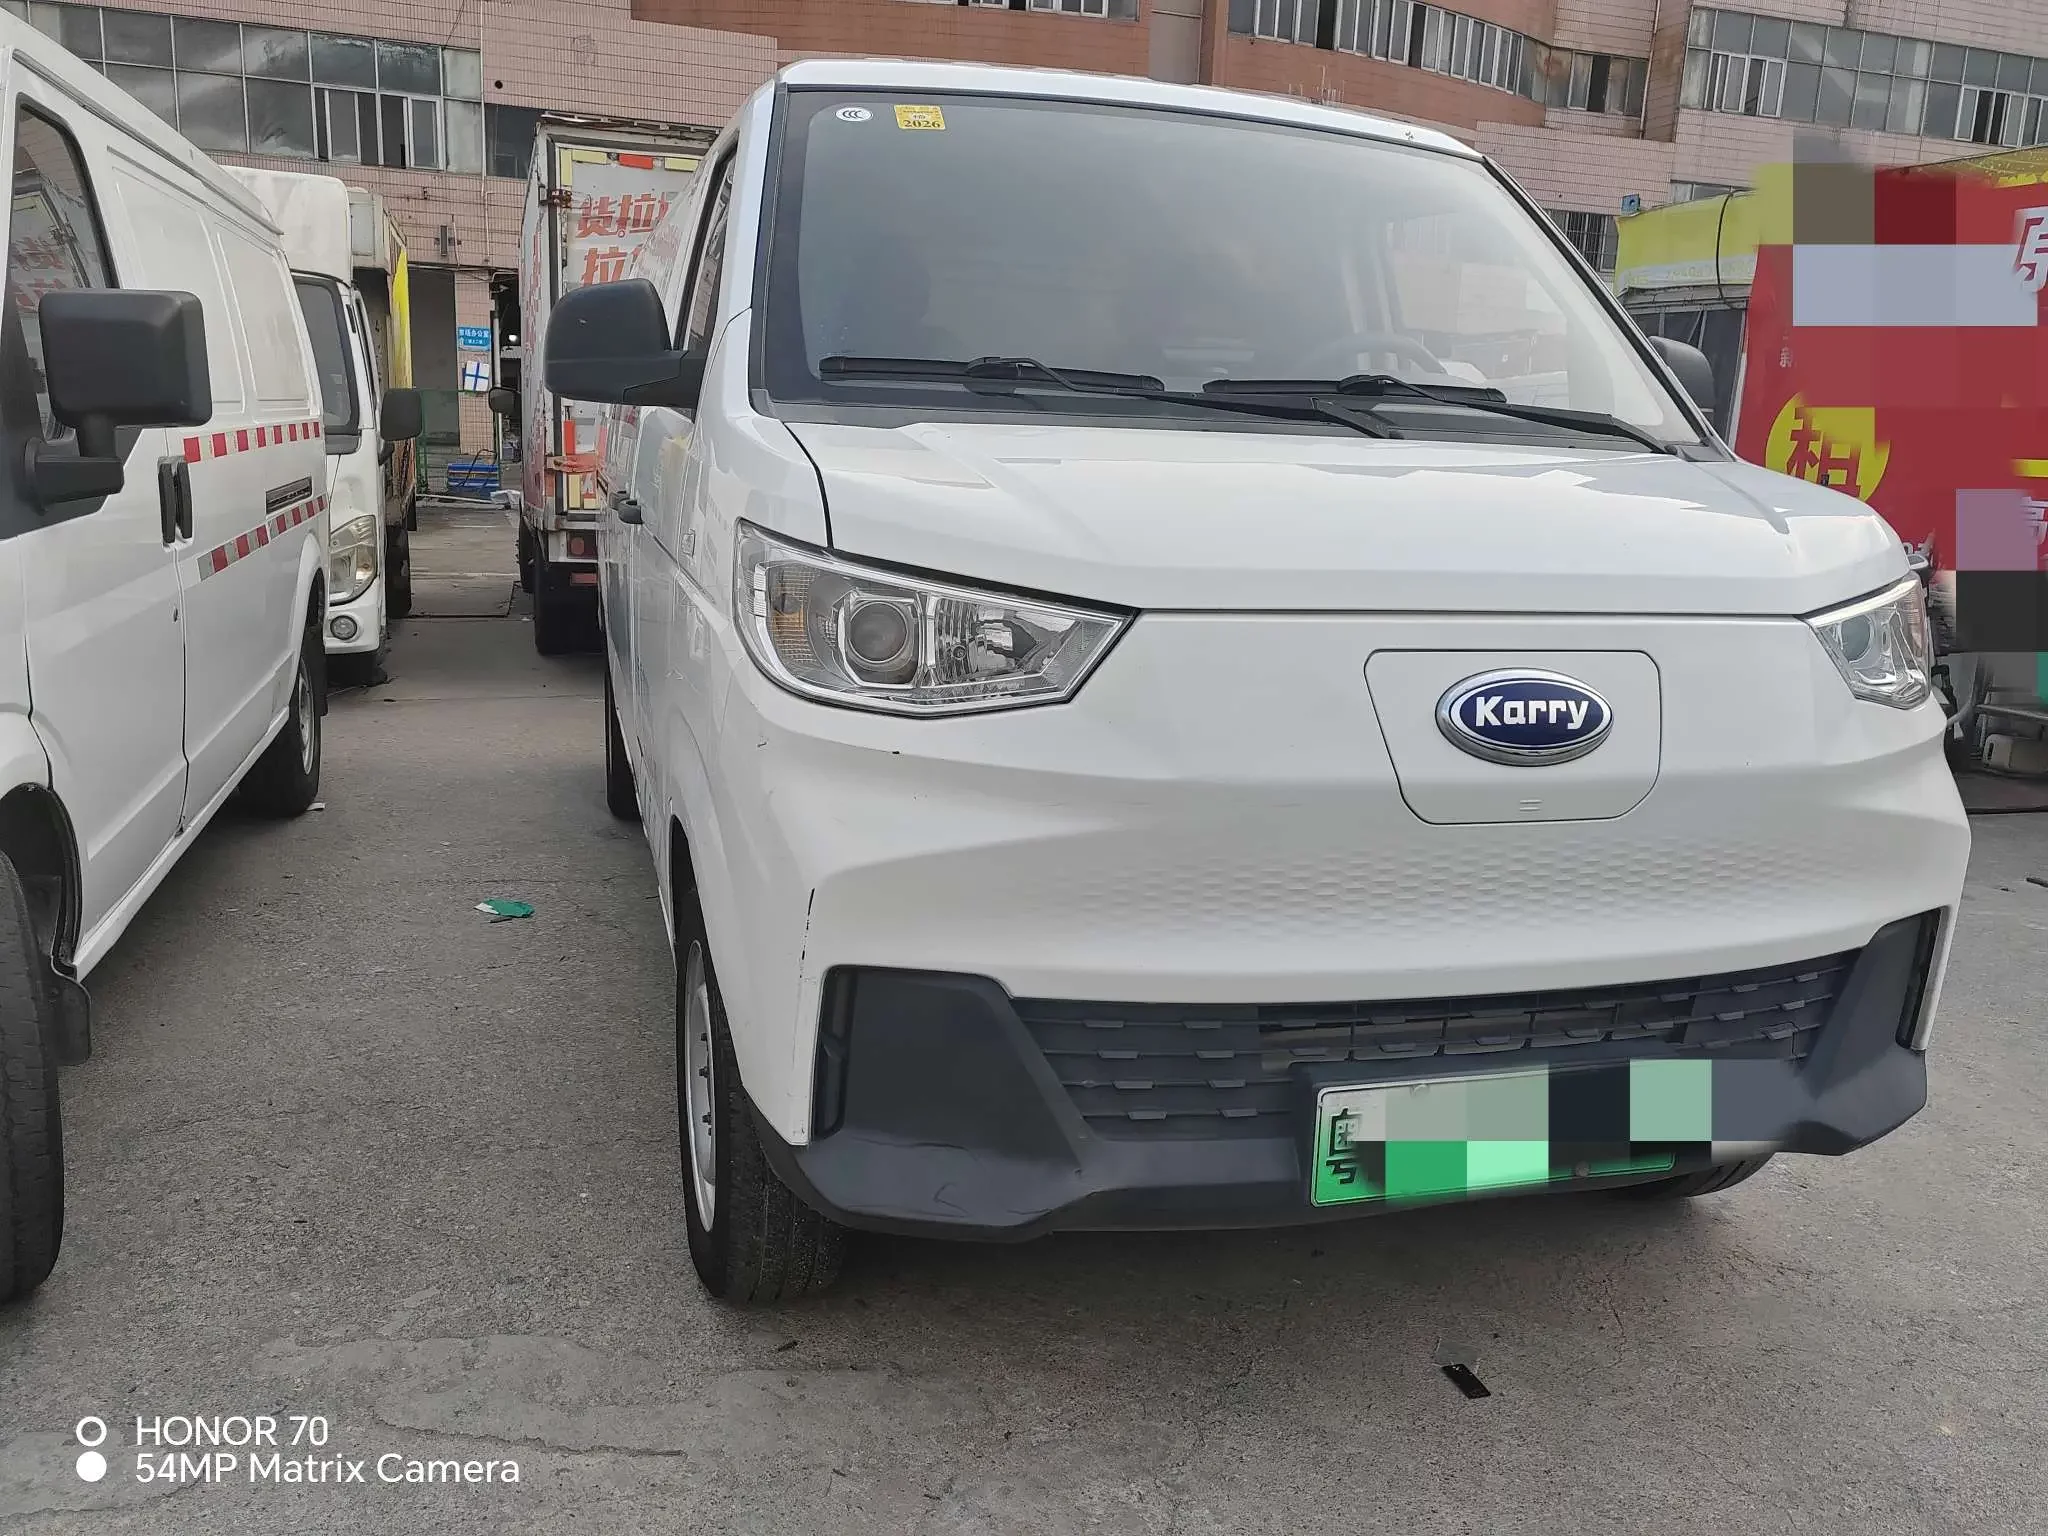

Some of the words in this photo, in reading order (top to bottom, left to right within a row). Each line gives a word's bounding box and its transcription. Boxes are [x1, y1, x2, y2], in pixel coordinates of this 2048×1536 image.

[903, 119, 941, 128] 2026
[575, 191, 669, 238] 货拉
[581, 244, 644, 287] 拉
[1475, 695, 1590, 730] Karry
